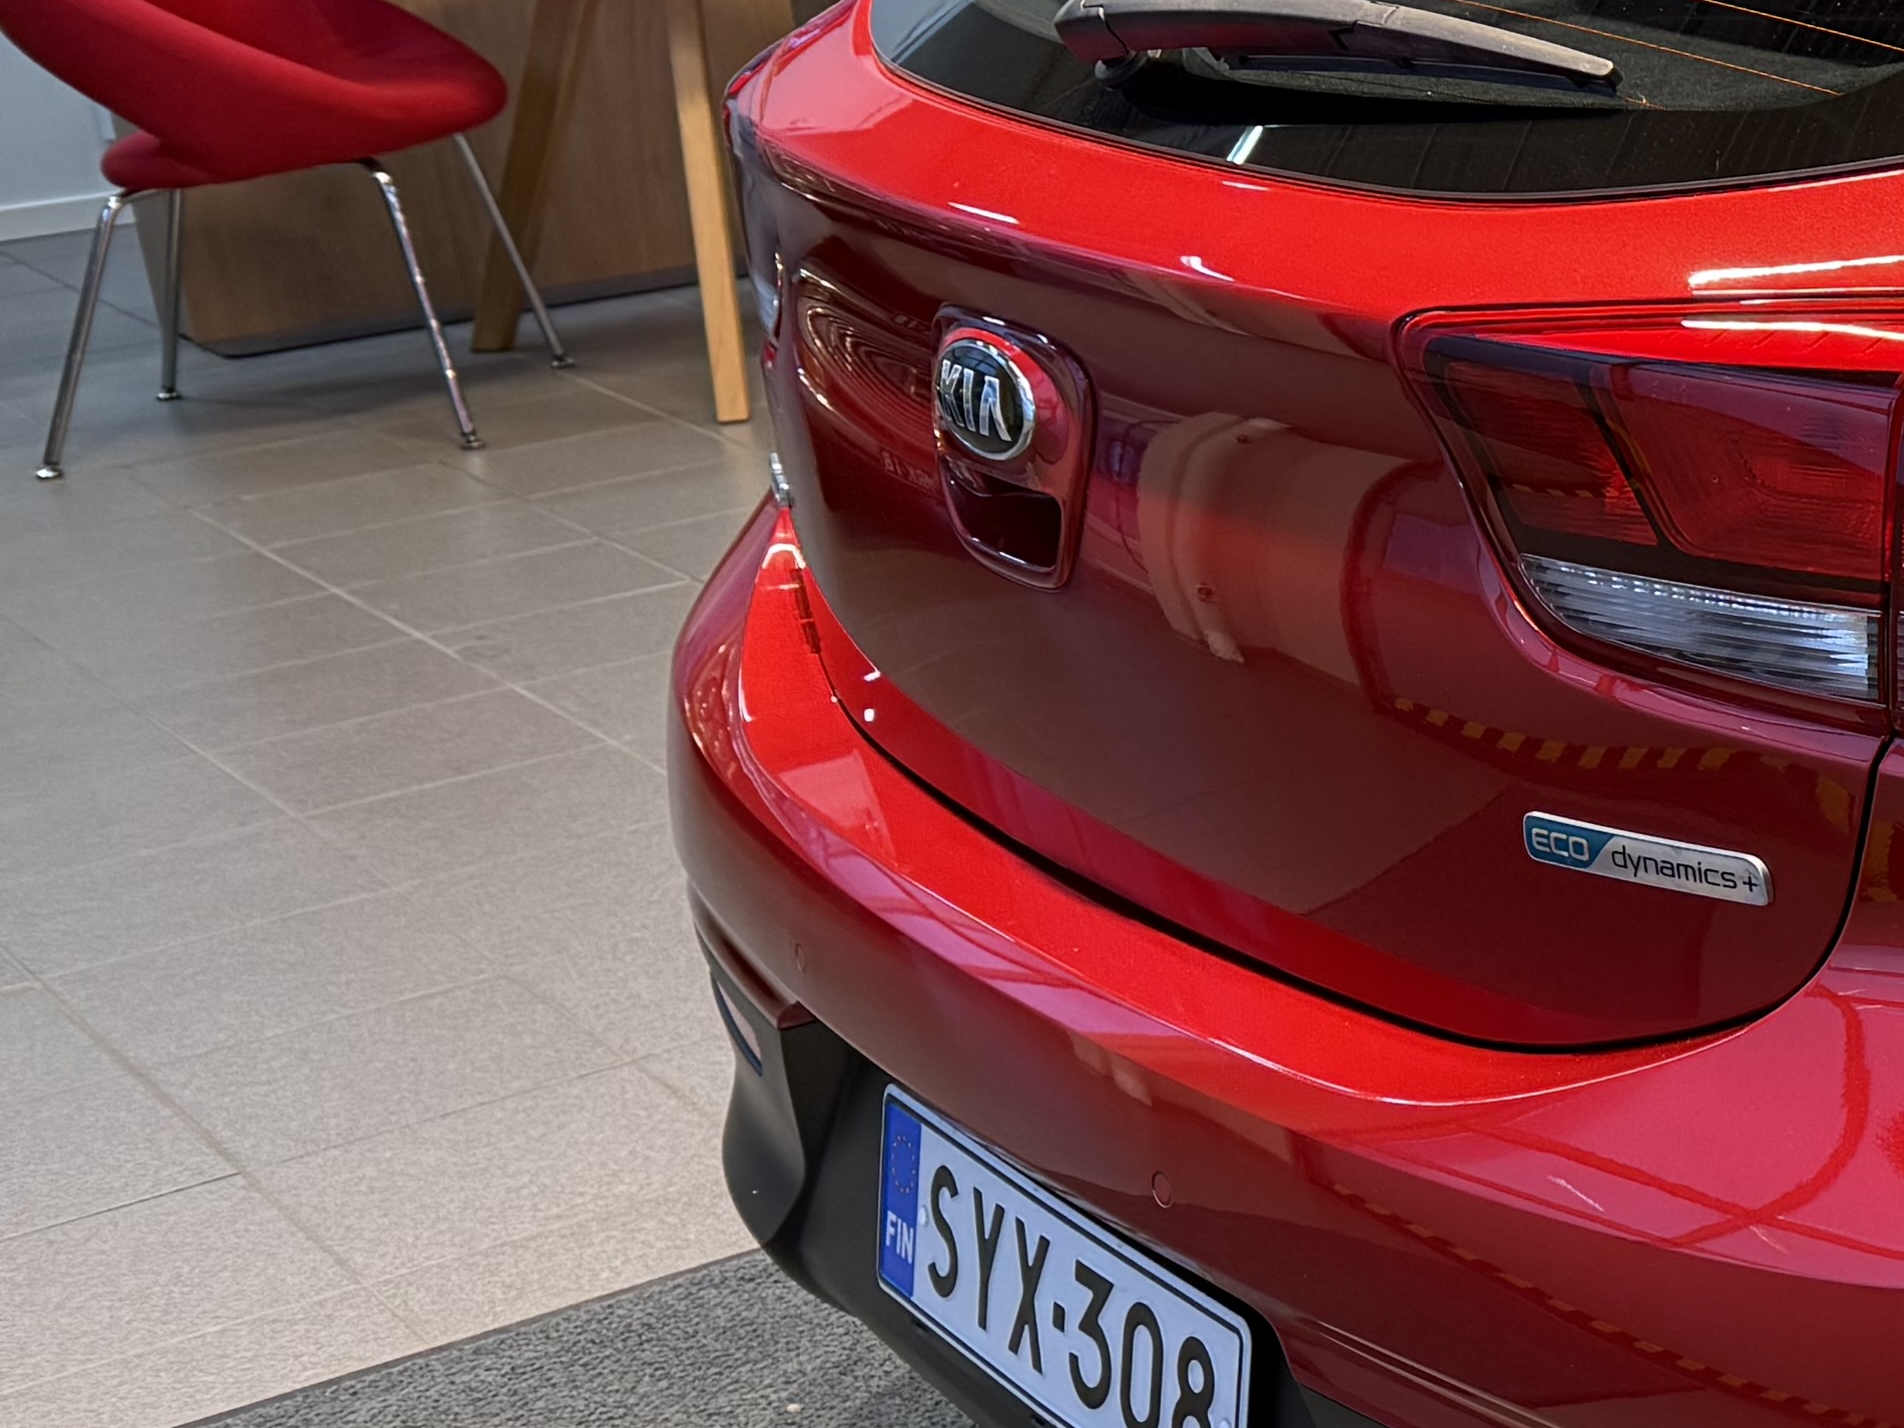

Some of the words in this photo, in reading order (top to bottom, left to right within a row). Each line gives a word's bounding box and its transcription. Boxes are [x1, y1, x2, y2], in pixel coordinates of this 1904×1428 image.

[940, 359, 1012, 442] KIA
[1531, 827, 1590, 861] ECO
[885, 1211, 915, 1265] FIN
